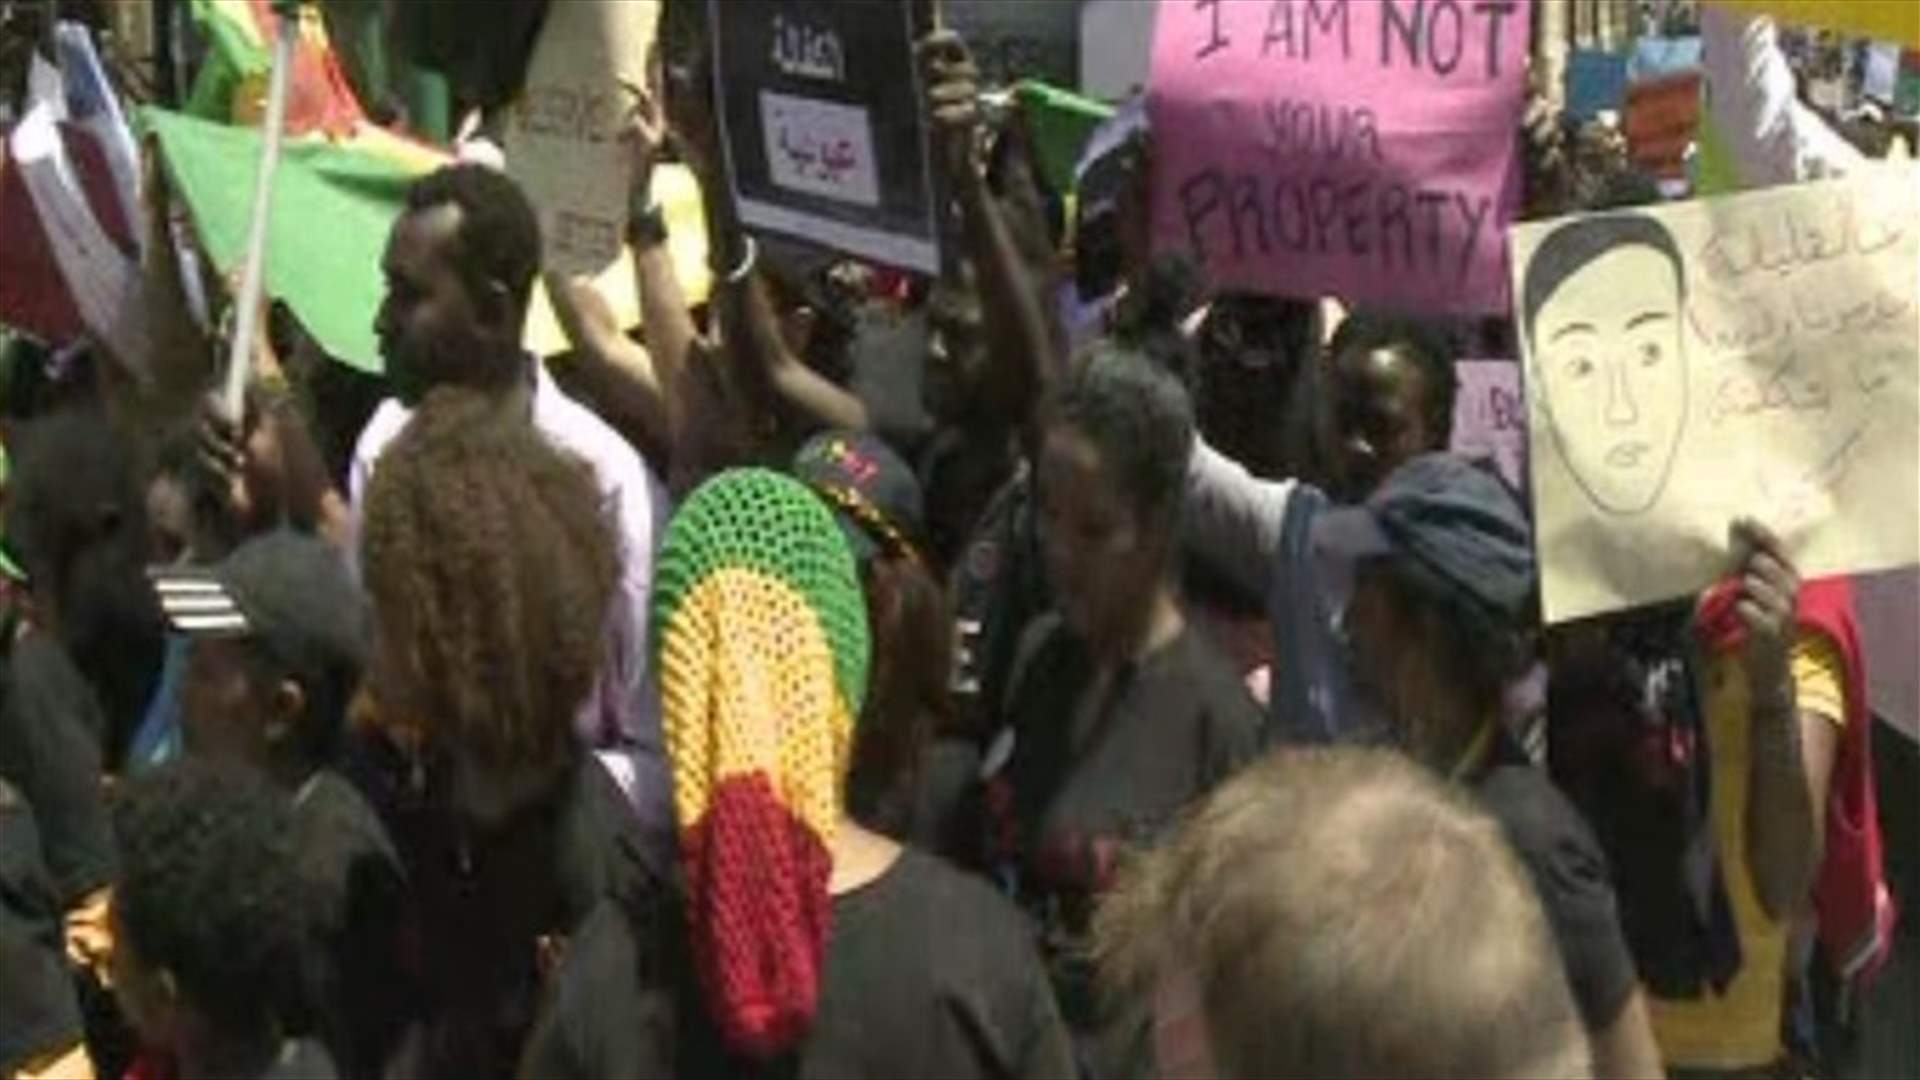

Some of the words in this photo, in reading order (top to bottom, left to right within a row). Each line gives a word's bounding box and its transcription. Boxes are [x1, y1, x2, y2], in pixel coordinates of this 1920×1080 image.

[1196, 0, 1230, 59] I
[1262, 0, 1350, 61] AM
[1380, 0, 1515, 78] NOT
[1262, 98, 1384, 163] YOUR
[1179, 166, 1491, 280] PROPERTY
